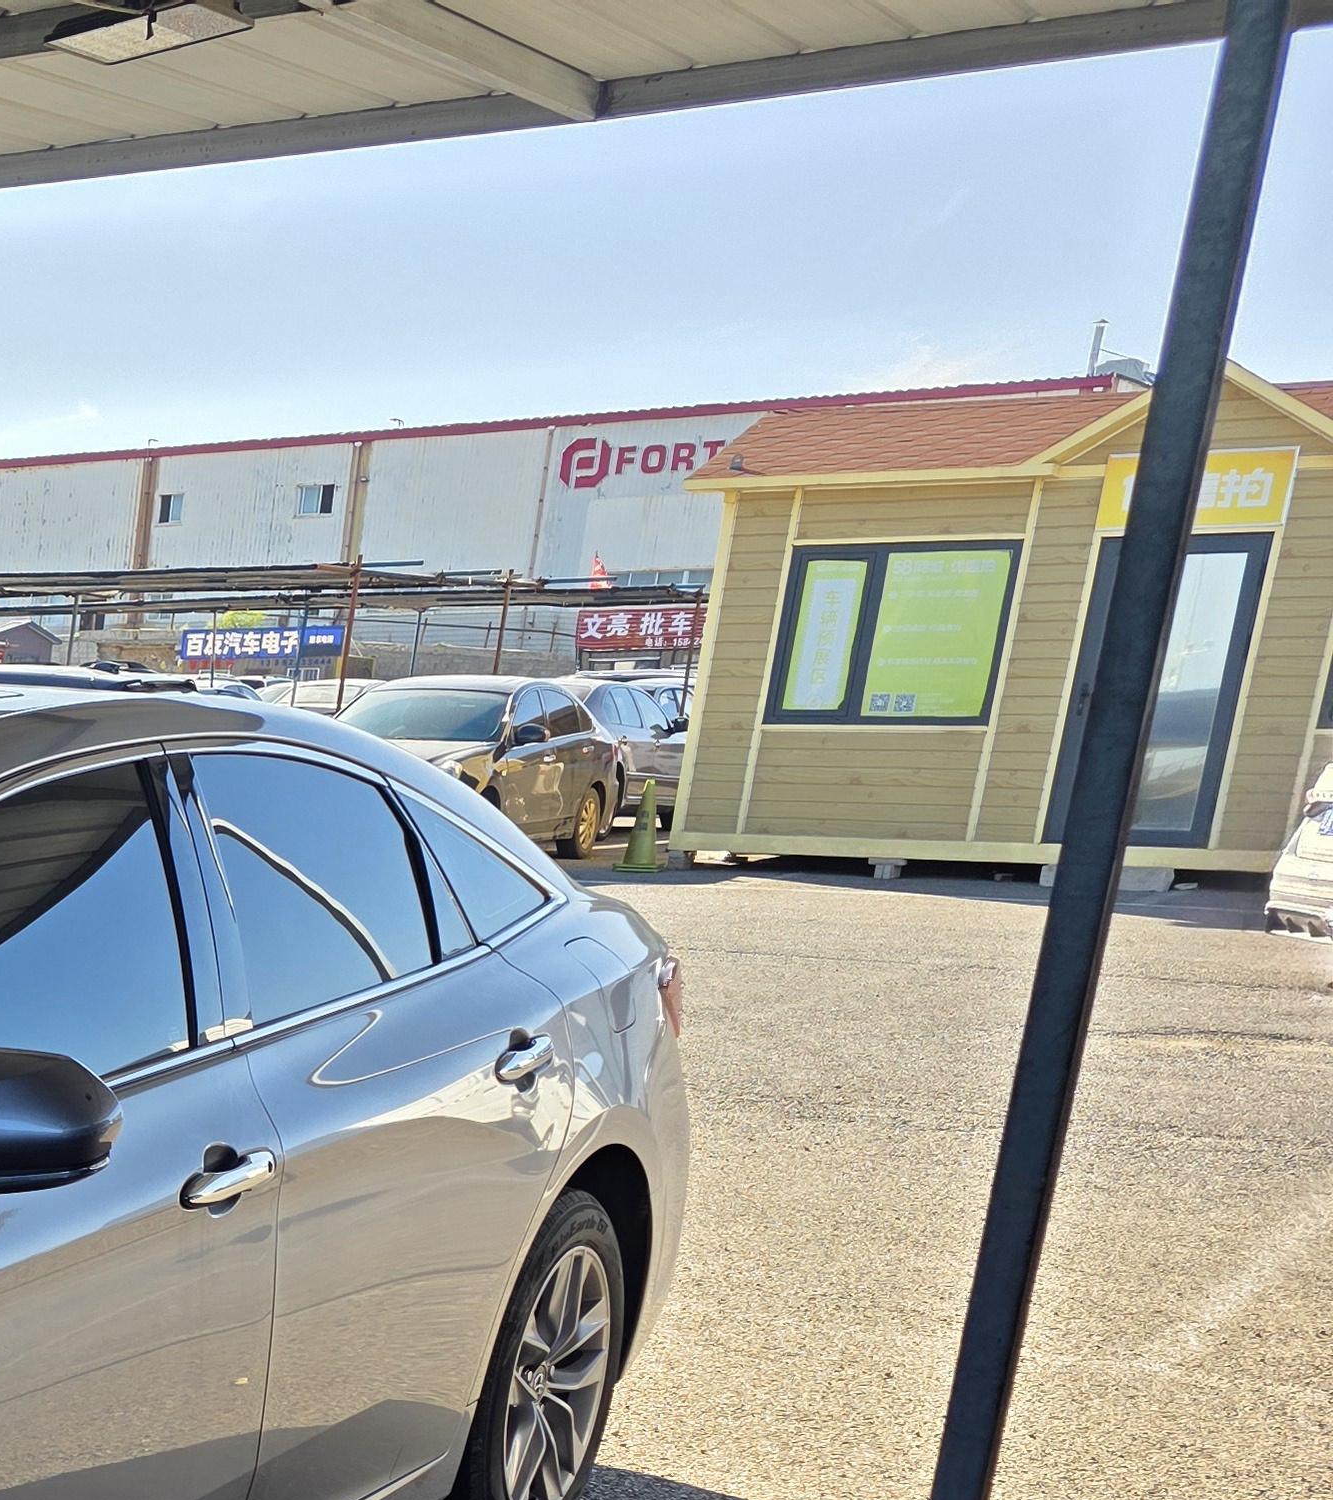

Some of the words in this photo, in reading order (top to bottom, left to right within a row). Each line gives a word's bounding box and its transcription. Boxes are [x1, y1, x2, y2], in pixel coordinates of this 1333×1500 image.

[580, 613, 633, 639] 文亮
[186, 630, 300, 657] 百友汽车电子
